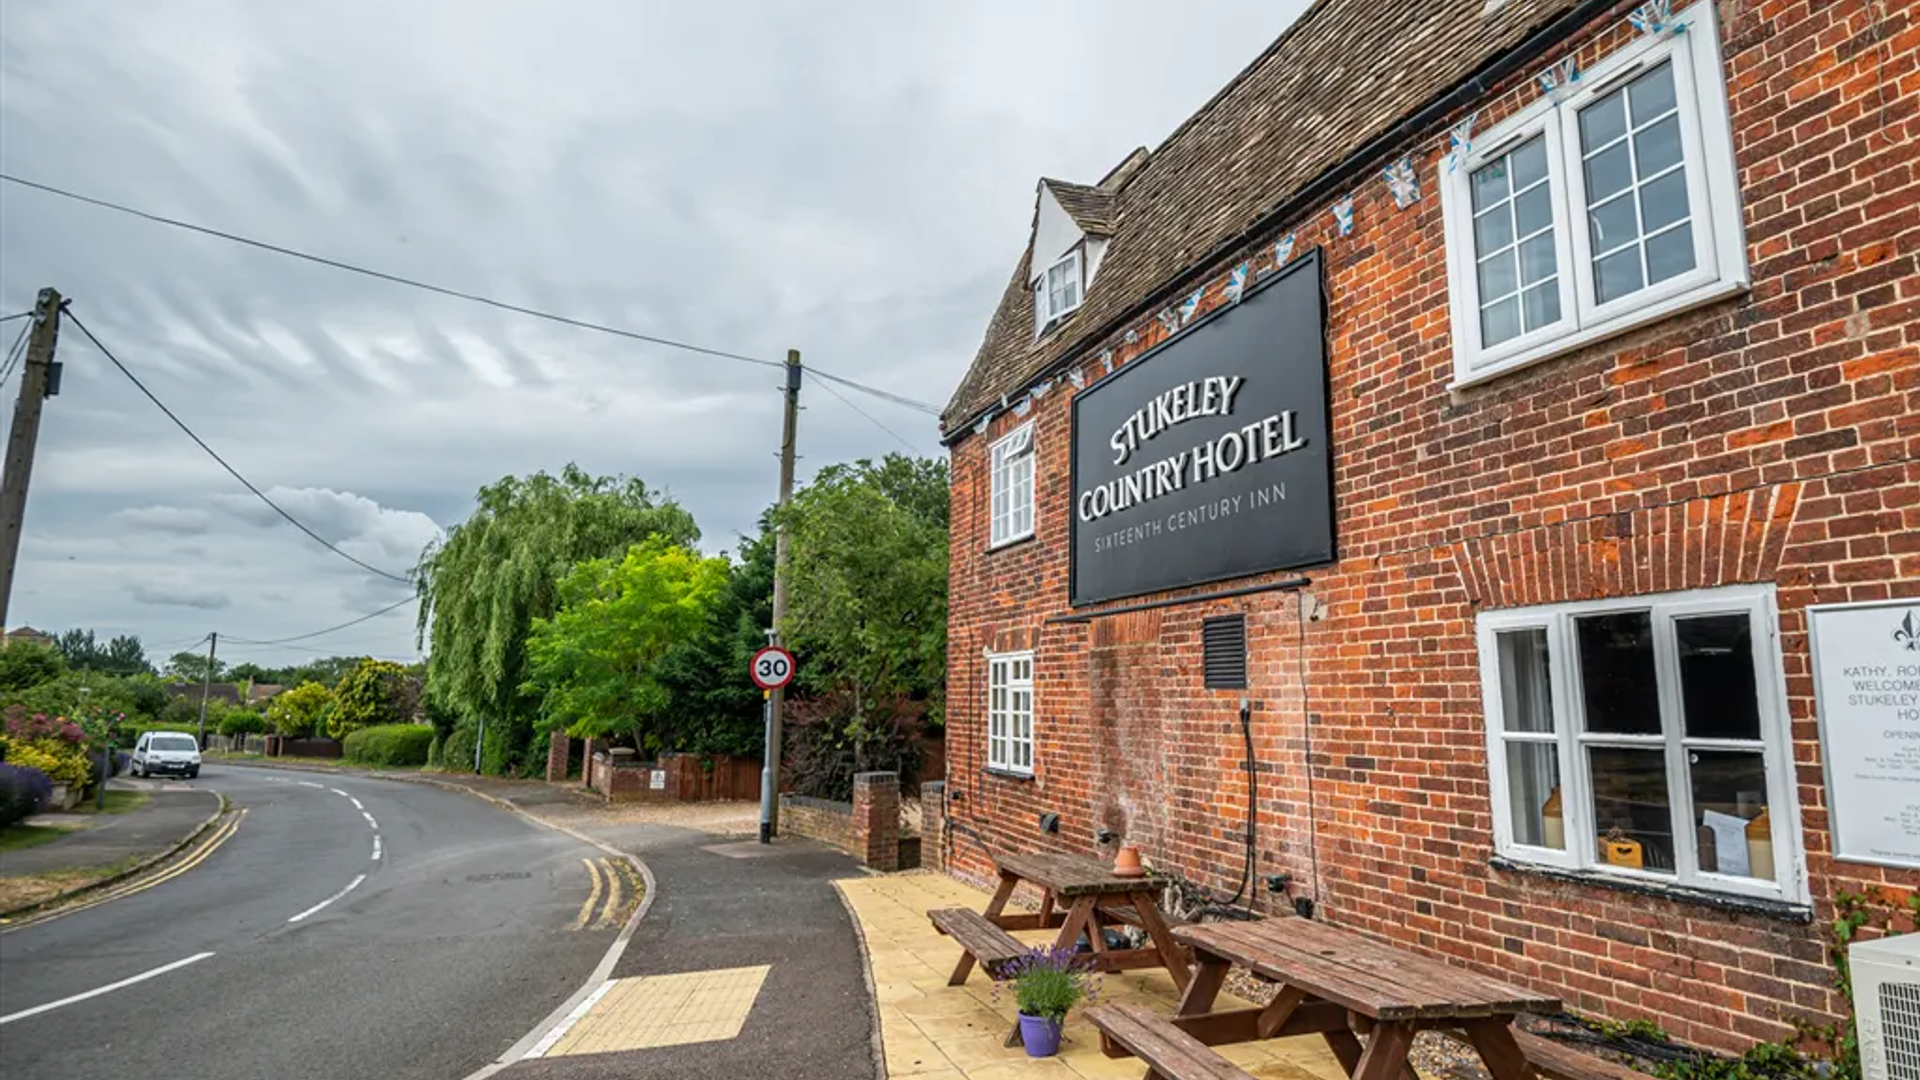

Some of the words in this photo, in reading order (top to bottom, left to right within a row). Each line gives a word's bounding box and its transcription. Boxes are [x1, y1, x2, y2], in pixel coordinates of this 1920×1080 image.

[1110, 376, 1243, 466] STUKELEY
[1079, 451, 1187, 522] COUNTRY
[1192, 409, 1306, 483] HOTEL
[1095, 519, 1162, 552] SIXTEENTH
[1167, 494, 1242, 532] CENTURY
[1250, 482, 1287, 509] INN
[758, 660, 788, 677] 30
[1853, 680, 1920, 691] WELCOME
[1848, 694, 1918, 706] STUKELEY
[1897, 708, 1920, 721] HO
